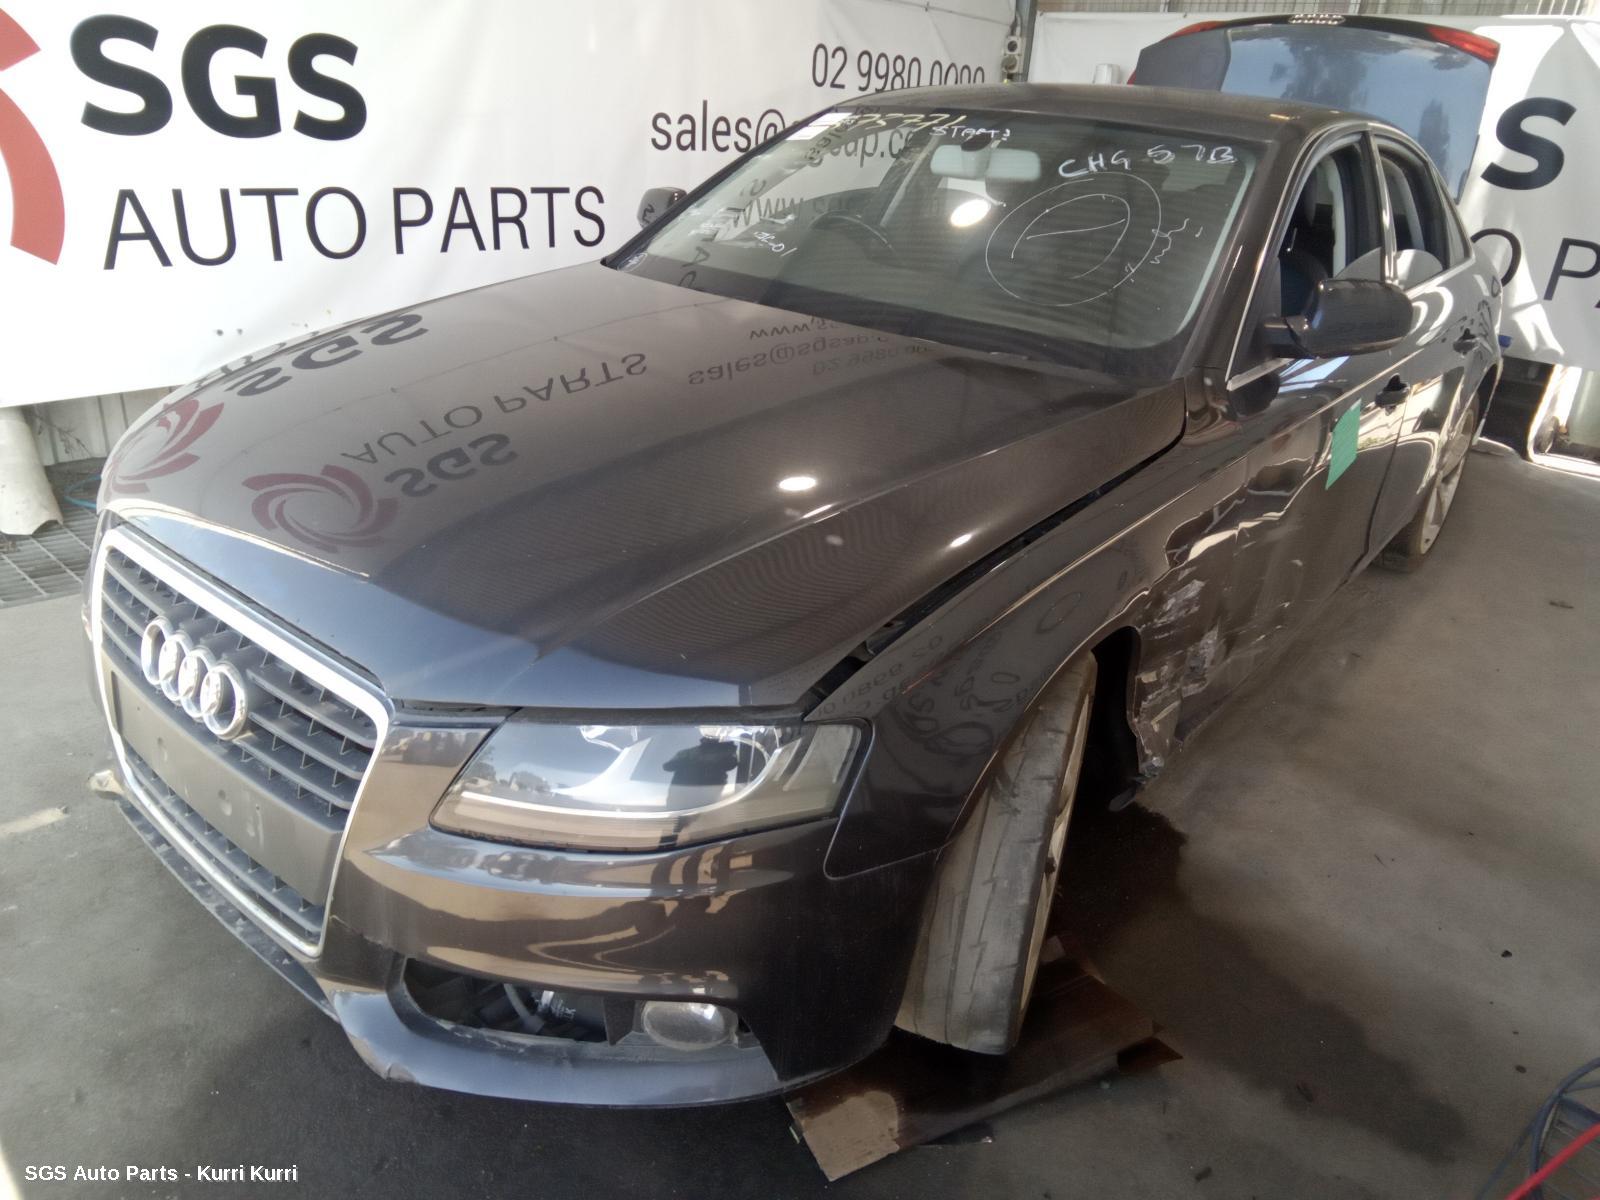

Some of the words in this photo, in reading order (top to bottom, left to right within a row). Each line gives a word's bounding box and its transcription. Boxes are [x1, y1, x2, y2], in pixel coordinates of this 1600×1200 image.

[70, 14, 367, 141] SGS
[812, 43, 848, 89] 02
[857, 50, 922, 92] 9980
[103, 186, 367, 270] AUTO
[392, 186, 606, 254] PARTS
